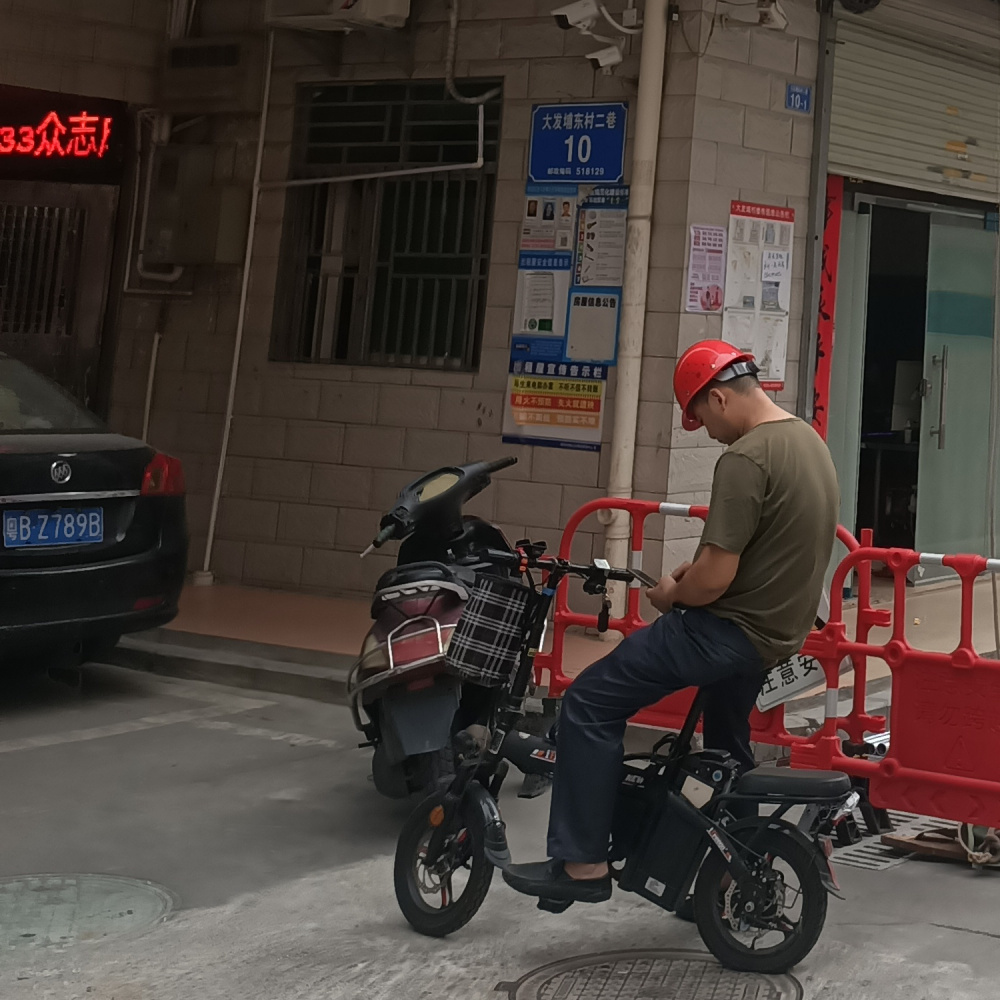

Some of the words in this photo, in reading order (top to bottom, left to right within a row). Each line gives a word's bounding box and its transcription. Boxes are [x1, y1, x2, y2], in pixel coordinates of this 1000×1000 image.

[542, 111, 617, 130] 大发埔东村二巷
[564, 135, 592, 163] 10
[575, 167, 605, 176] 518129
[573, 296, 616, 308] 房屋信息公告
